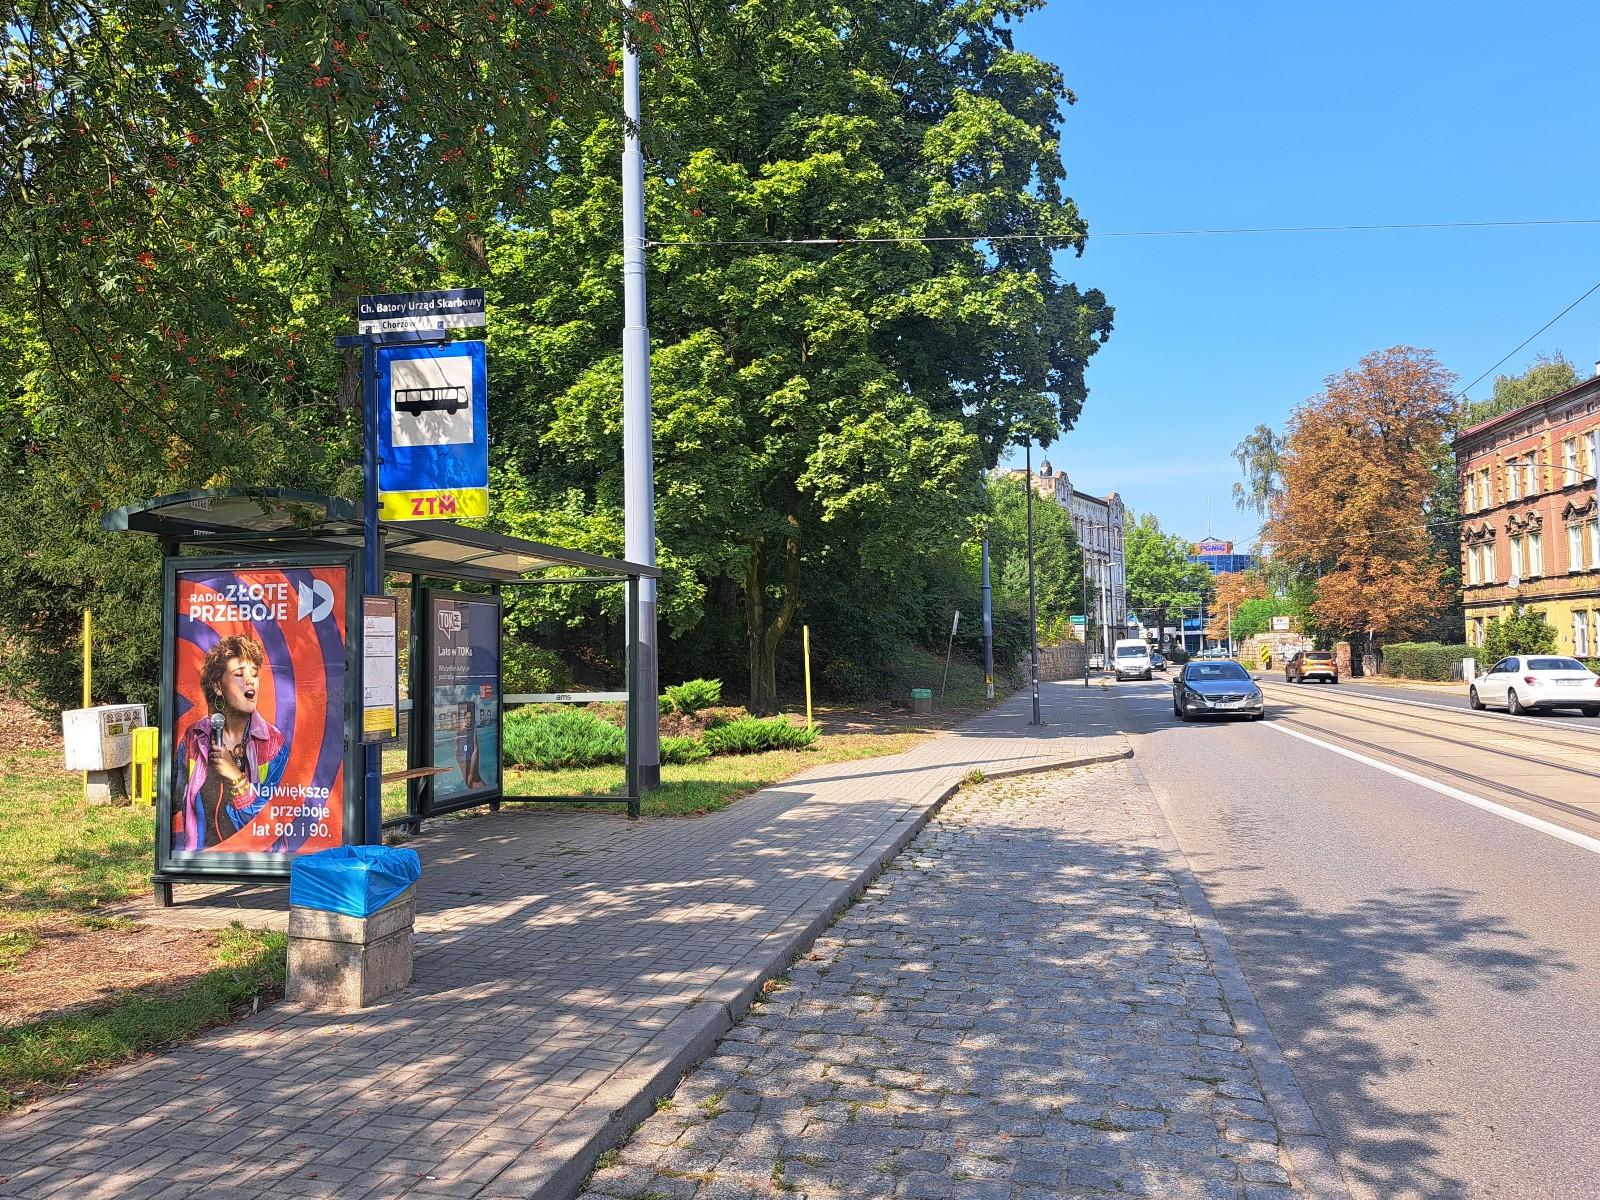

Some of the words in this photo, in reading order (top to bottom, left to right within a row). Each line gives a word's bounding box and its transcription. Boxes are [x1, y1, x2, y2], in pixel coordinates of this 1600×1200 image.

[360, 304, 374, 314] Ch.
[376, 303, 407, 314] Batory
[408, 300, 435, 311] Urząd
[437, 297, 482, 309] Skarbowy
[382, 320, 416, 330] Chorzów
[411, 494, 457, 516] ZTM
[190, 593, 225, 603] RADIO
[225, 583, 288, 602] ZŁOTE
[189, 603, 288, 622] PRZEBOJE
[439, 612, 454, 628] TOK
[249, 783, 330, 802] Największe
[270, 800, 330, 819] przeboje
[252, 822, 271, 837] lat
[274, 822, 297, 838] 80.
[301, 822, 305, 837] i
[309, 822, 332, 838] 90.
